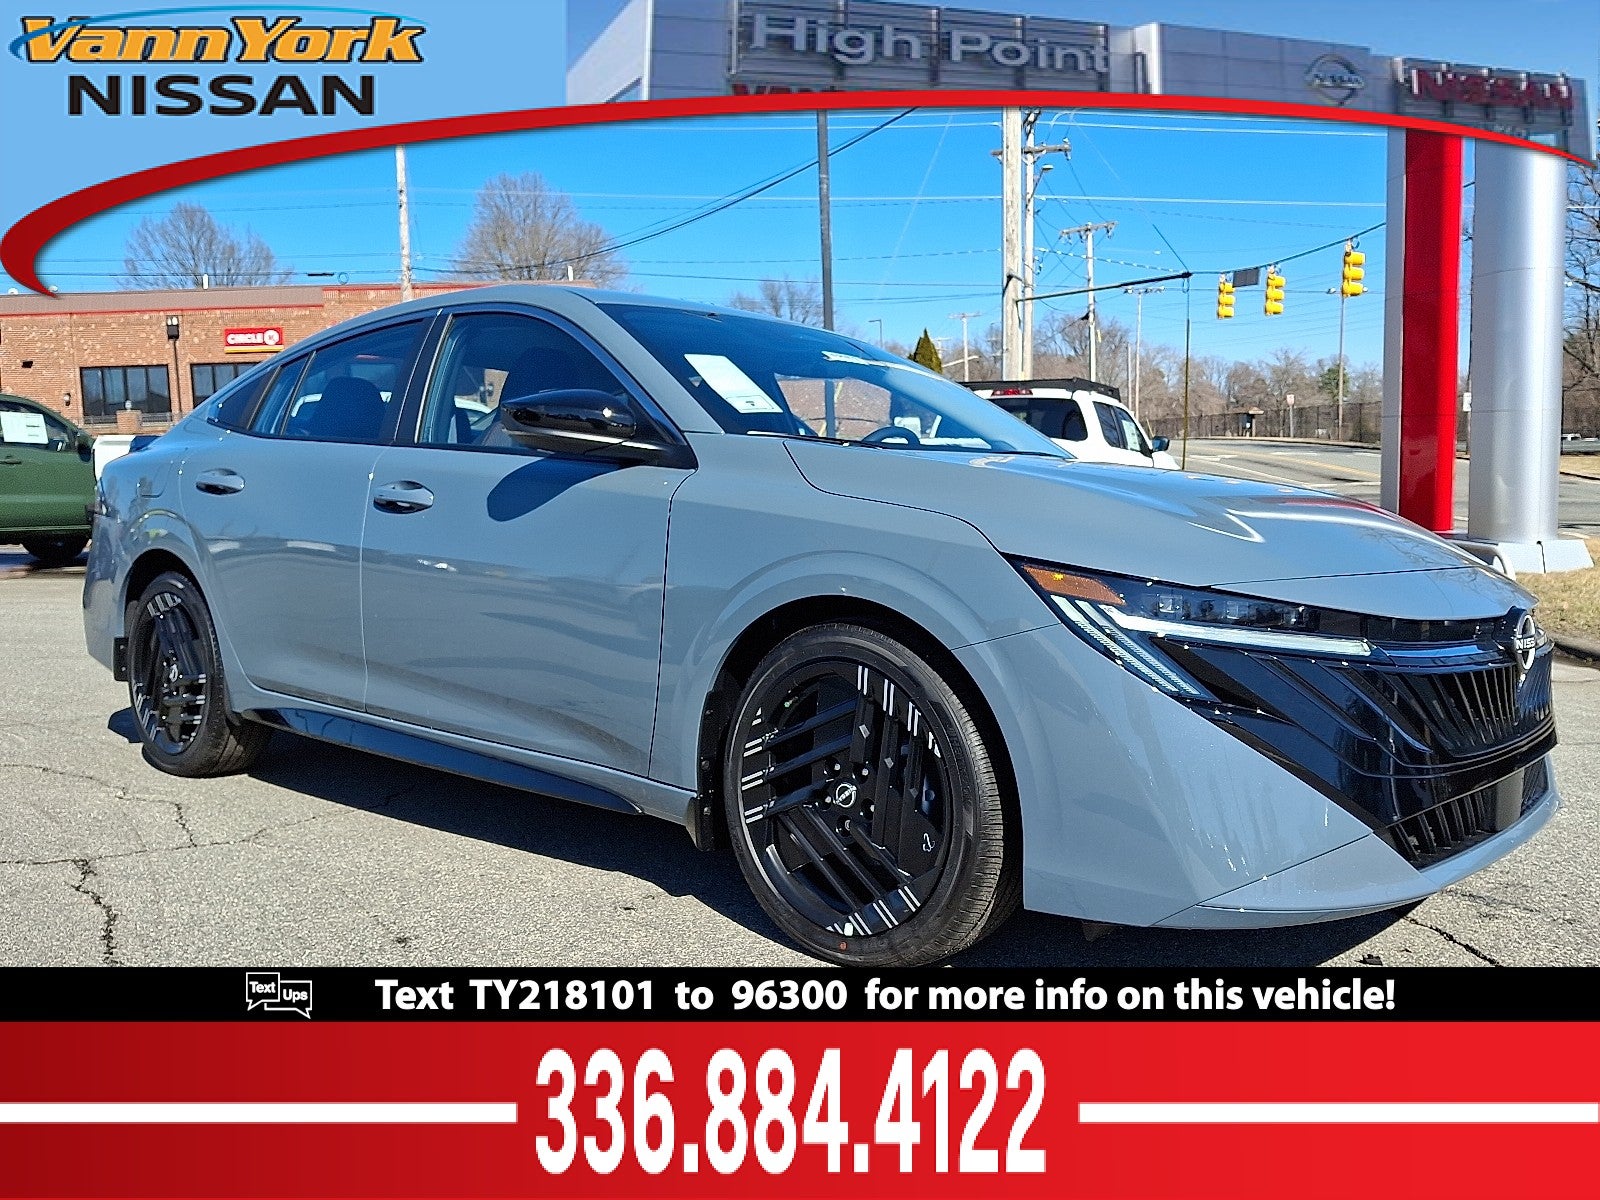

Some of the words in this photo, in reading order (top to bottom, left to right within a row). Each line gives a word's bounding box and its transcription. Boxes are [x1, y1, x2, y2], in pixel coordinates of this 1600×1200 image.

[751, 12, 923, 66] High
[949, 28, 1110, 73] Point
[226, 332, 263, 345] CIRCLE
